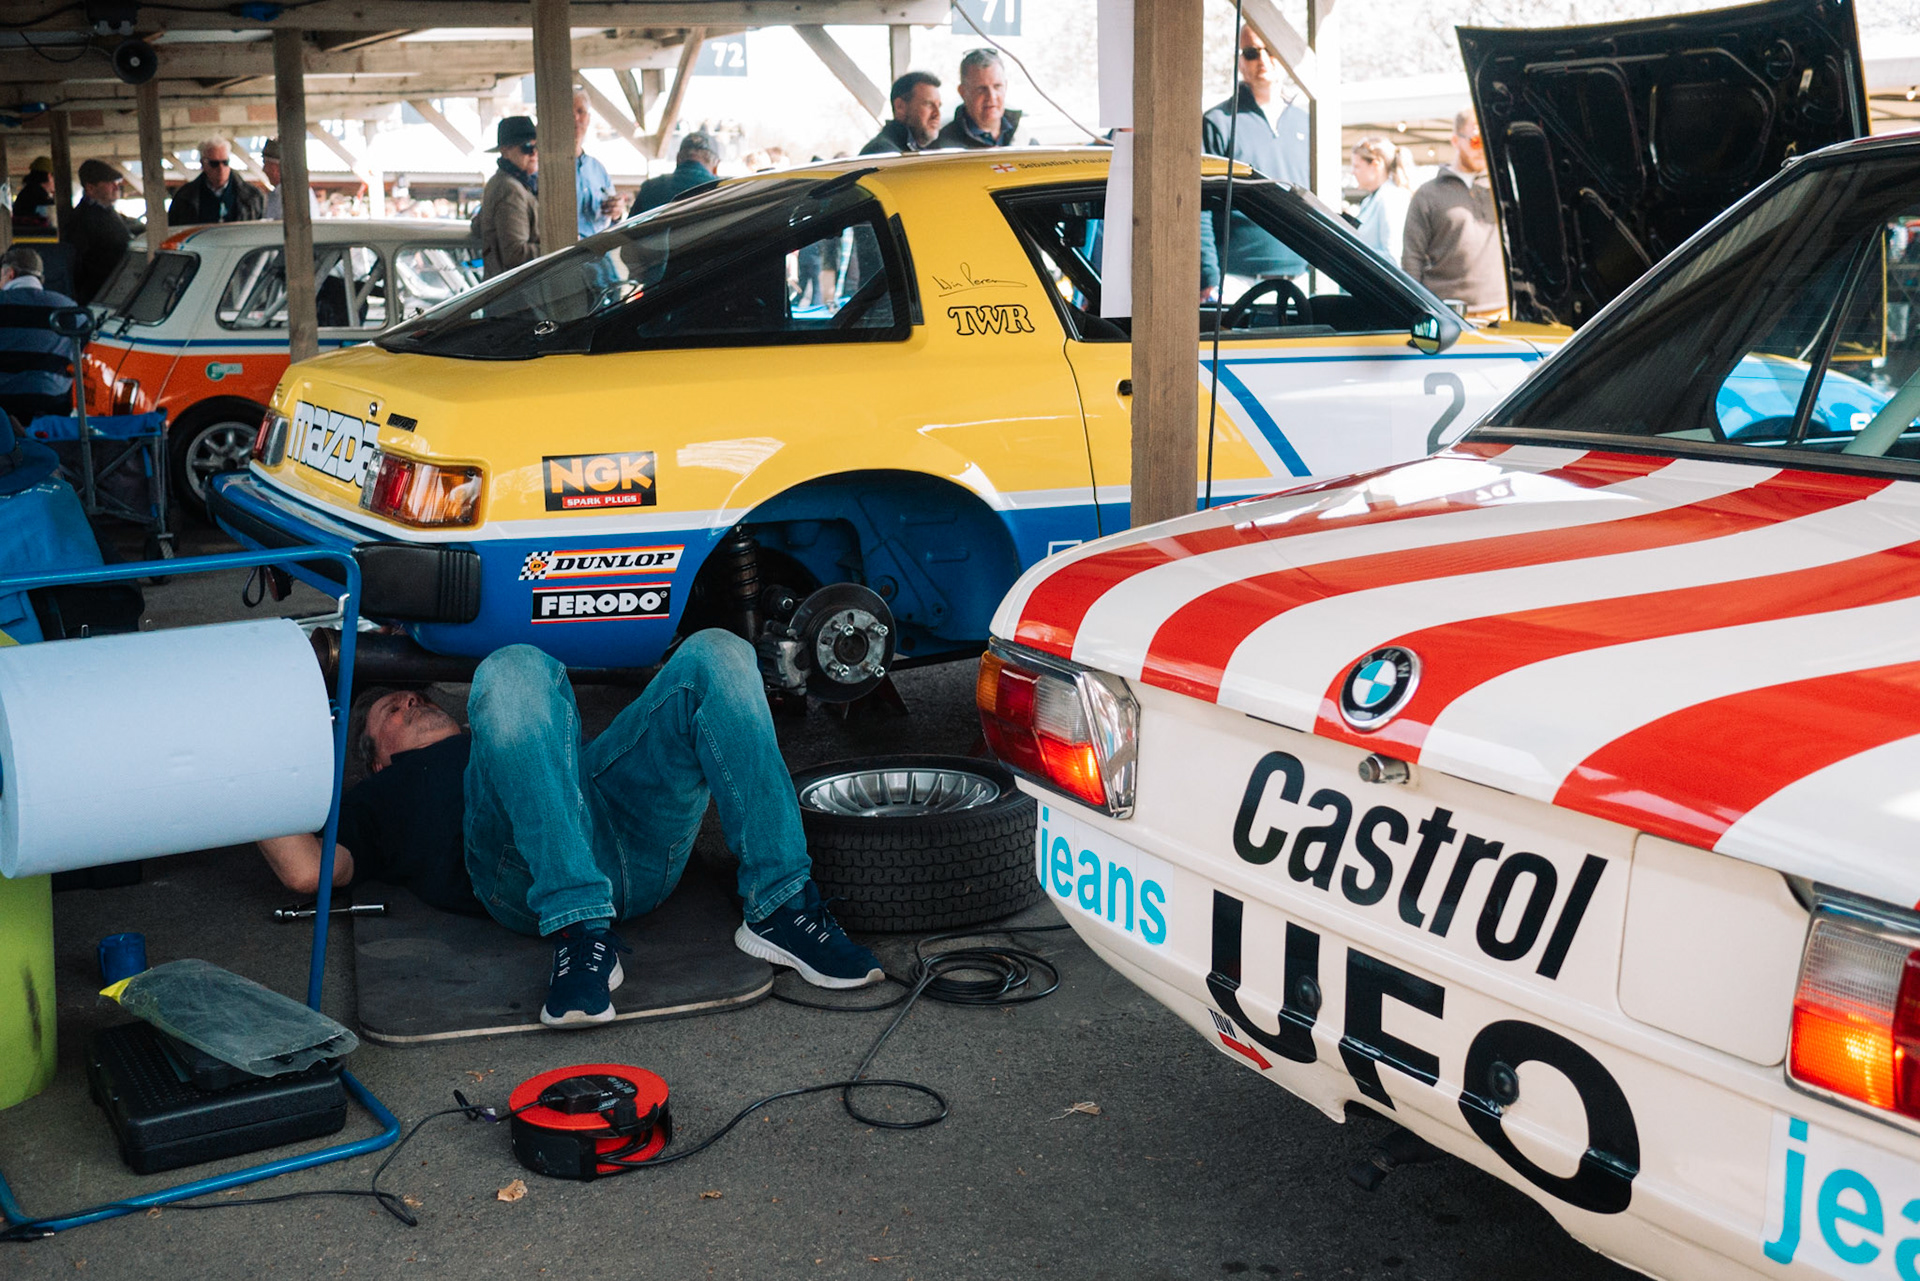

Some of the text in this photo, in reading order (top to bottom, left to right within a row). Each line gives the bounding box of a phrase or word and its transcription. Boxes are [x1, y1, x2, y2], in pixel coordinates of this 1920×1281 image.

[711, 42, 744, 68] 72
[1018, 159, 1072, 169] Sebastian
[947, 304, 1035, 335] TWR
[1424, 372, 1465, 456] 2
[549, 455, 653, 494] NGK
[567, 495, 637, 506] SPARK PLUGS
[553, 552, 675, 571] DUNLOP
[541, 591, 662, 616] FERODO
[1360, 649, 1410, 678] BMW
[1041, 806, 1167, 945] jeans
[1233, 750, 1609, 981] Castrol
[1207, 1008, 1237, 1040] TOW
[1206, 889, 1640, 1214] UFO
